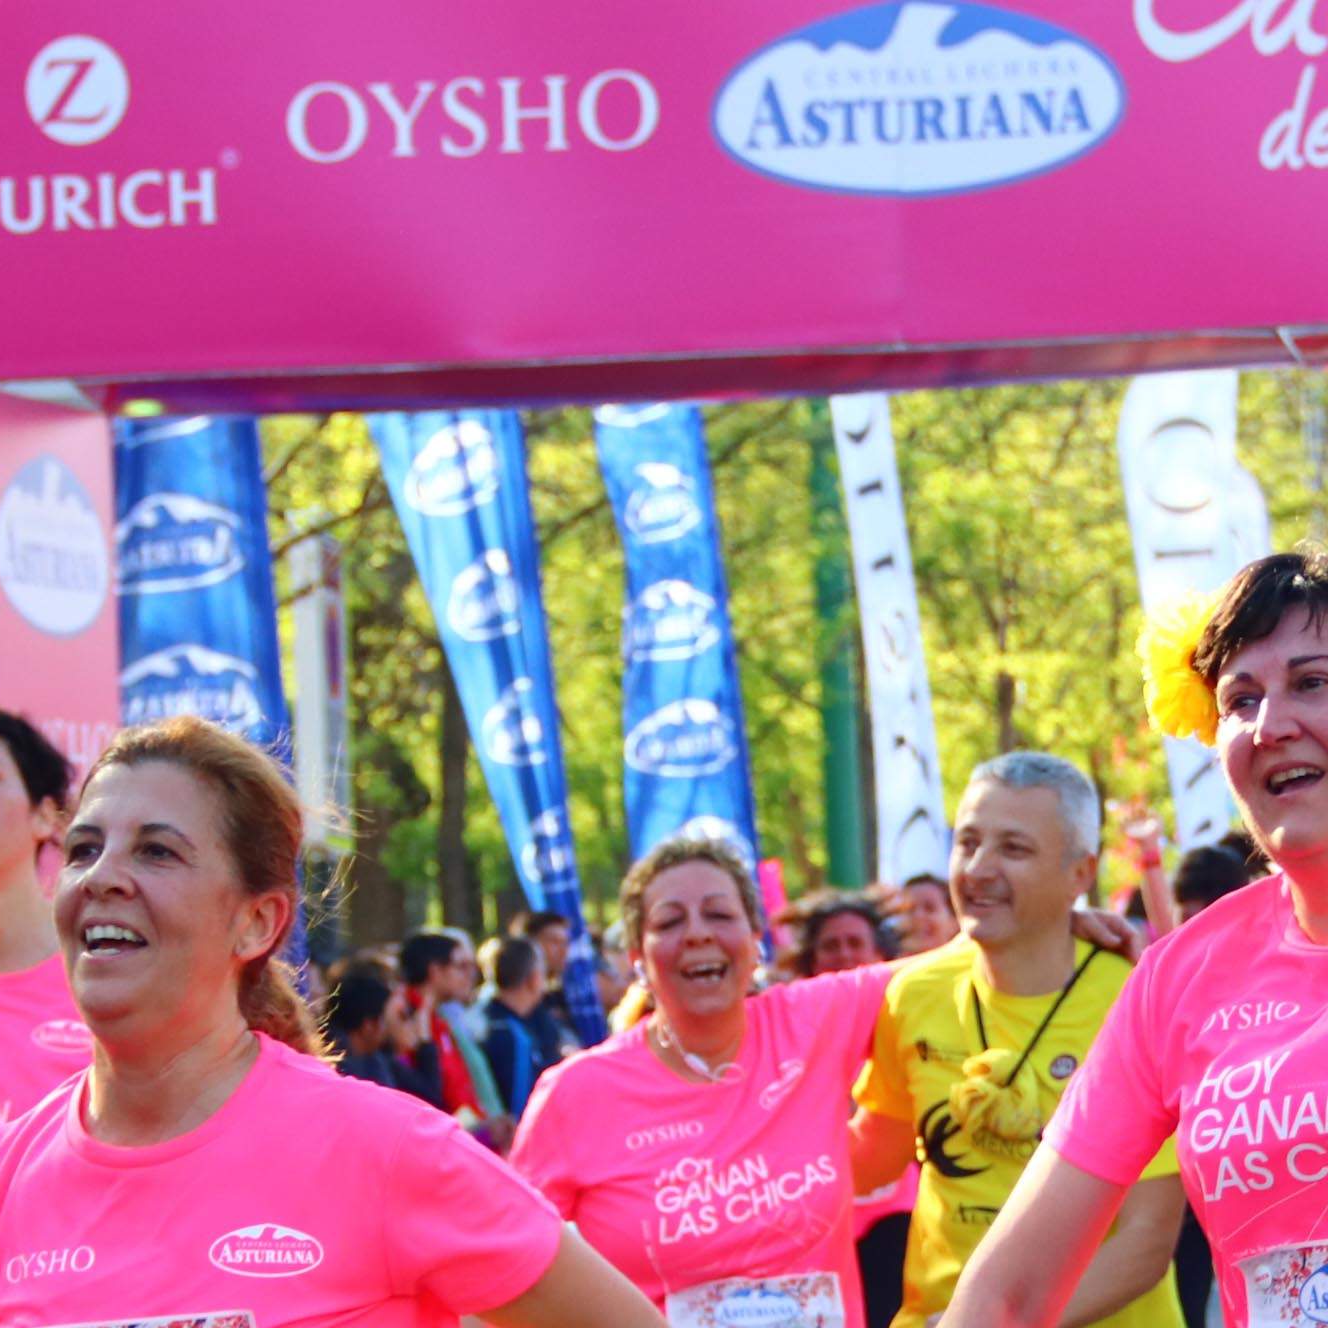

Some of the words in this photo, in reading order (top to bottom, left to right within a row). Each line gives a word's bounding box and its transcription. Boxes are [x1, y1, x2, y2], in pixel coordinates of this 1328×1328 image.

[286, 68, 660, 163] OYSHO
[745, 75, 1093, 151] ASTURIANA
[1193, 1050, 1292, 1107] HOY
[625, 1120, 705, 1151] OYSHO
[654, 1154, 770, 1214] GANAN
[658, 1204, 720, 1245] LAS
[725, 1154, 838, 1224] CHICAS
[1194, 1151, 1275, 1202] LAS
[218, 1242, 315, 1265] ASTURIANA
